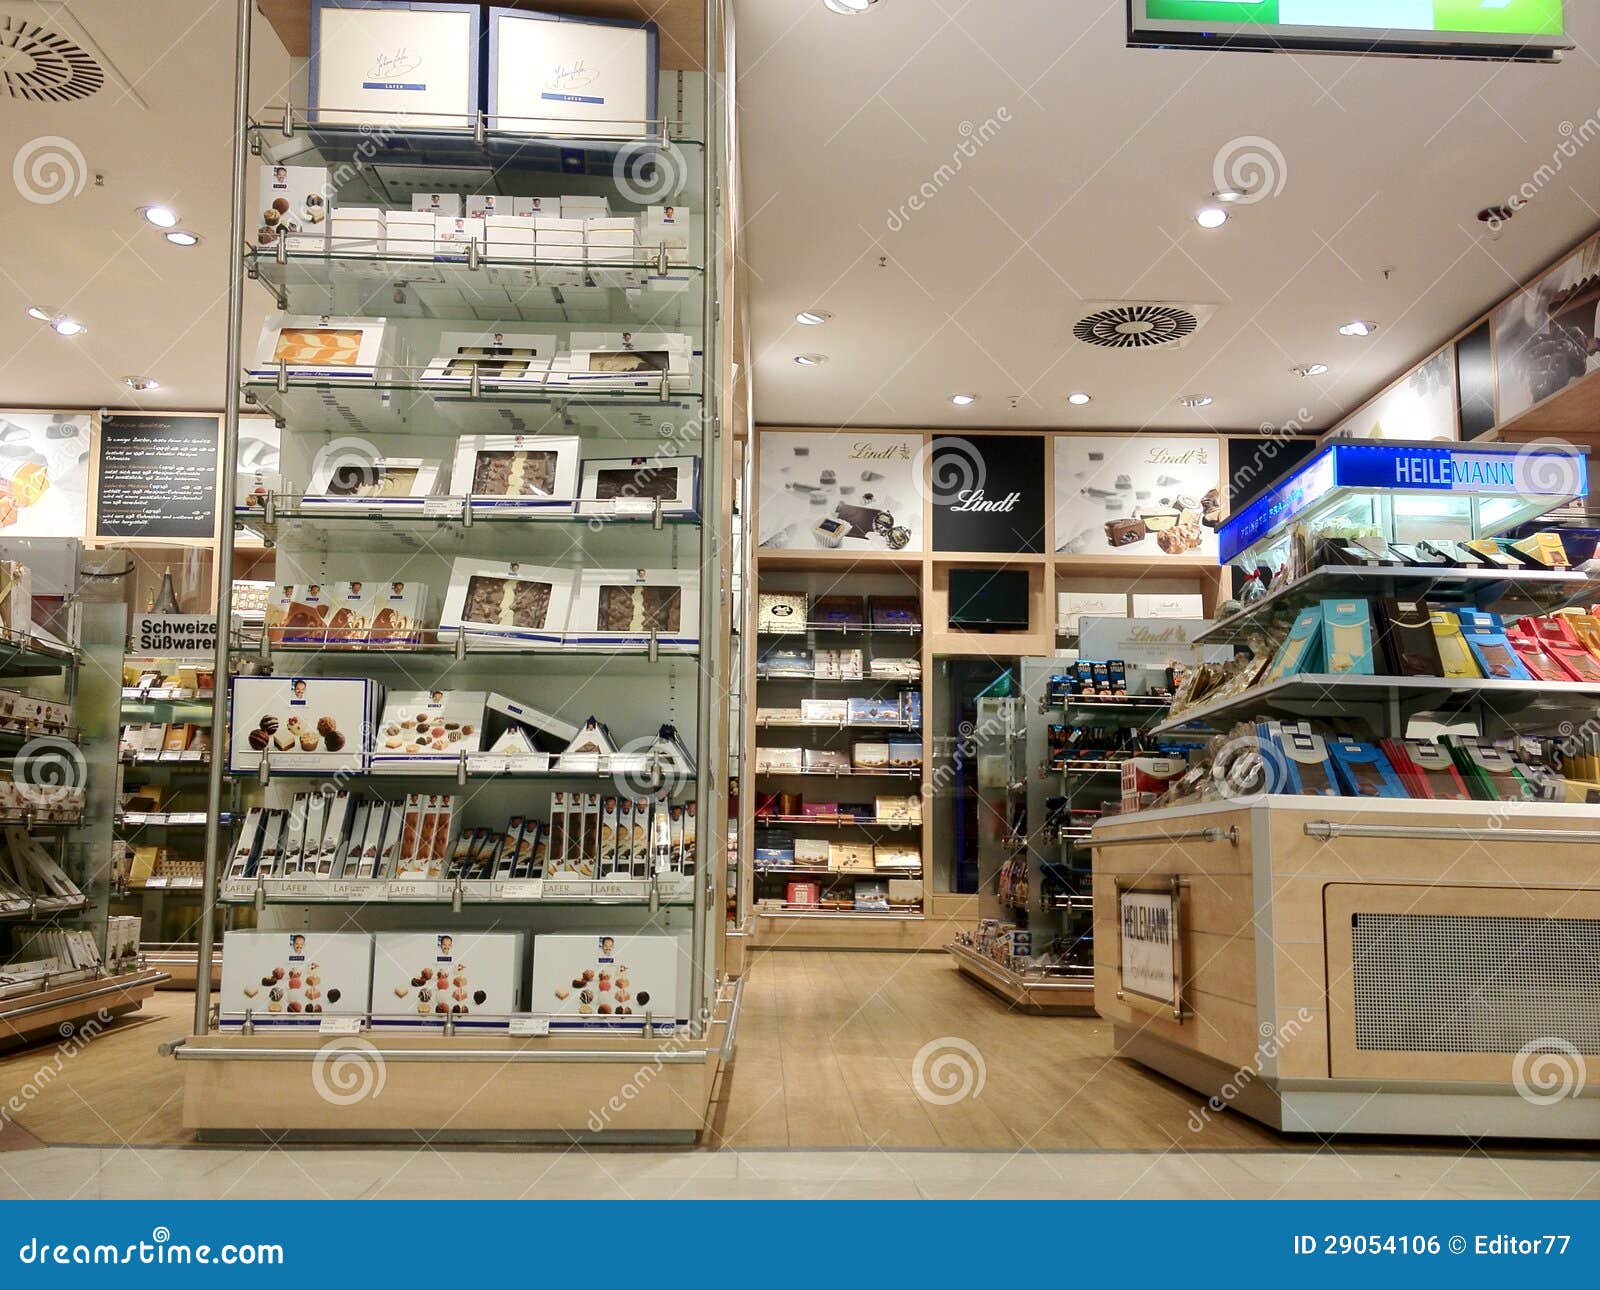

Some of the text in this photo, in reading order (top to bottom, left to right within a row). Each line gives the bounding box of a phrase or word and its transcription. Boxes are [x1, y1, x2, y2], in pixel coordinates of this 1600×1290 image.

[848, 441, 898, 459] Lindt
[1144, 447, 1195, 464] Lindt
[1395, 457, 1514, 486] HEILEMANN
[950, 489, 1021, 512] Lindt
[141, 619, 217, 635] Schweize
[281, 883, 307, 891] LAFER
[389, 884, 416, 893] LAFER
